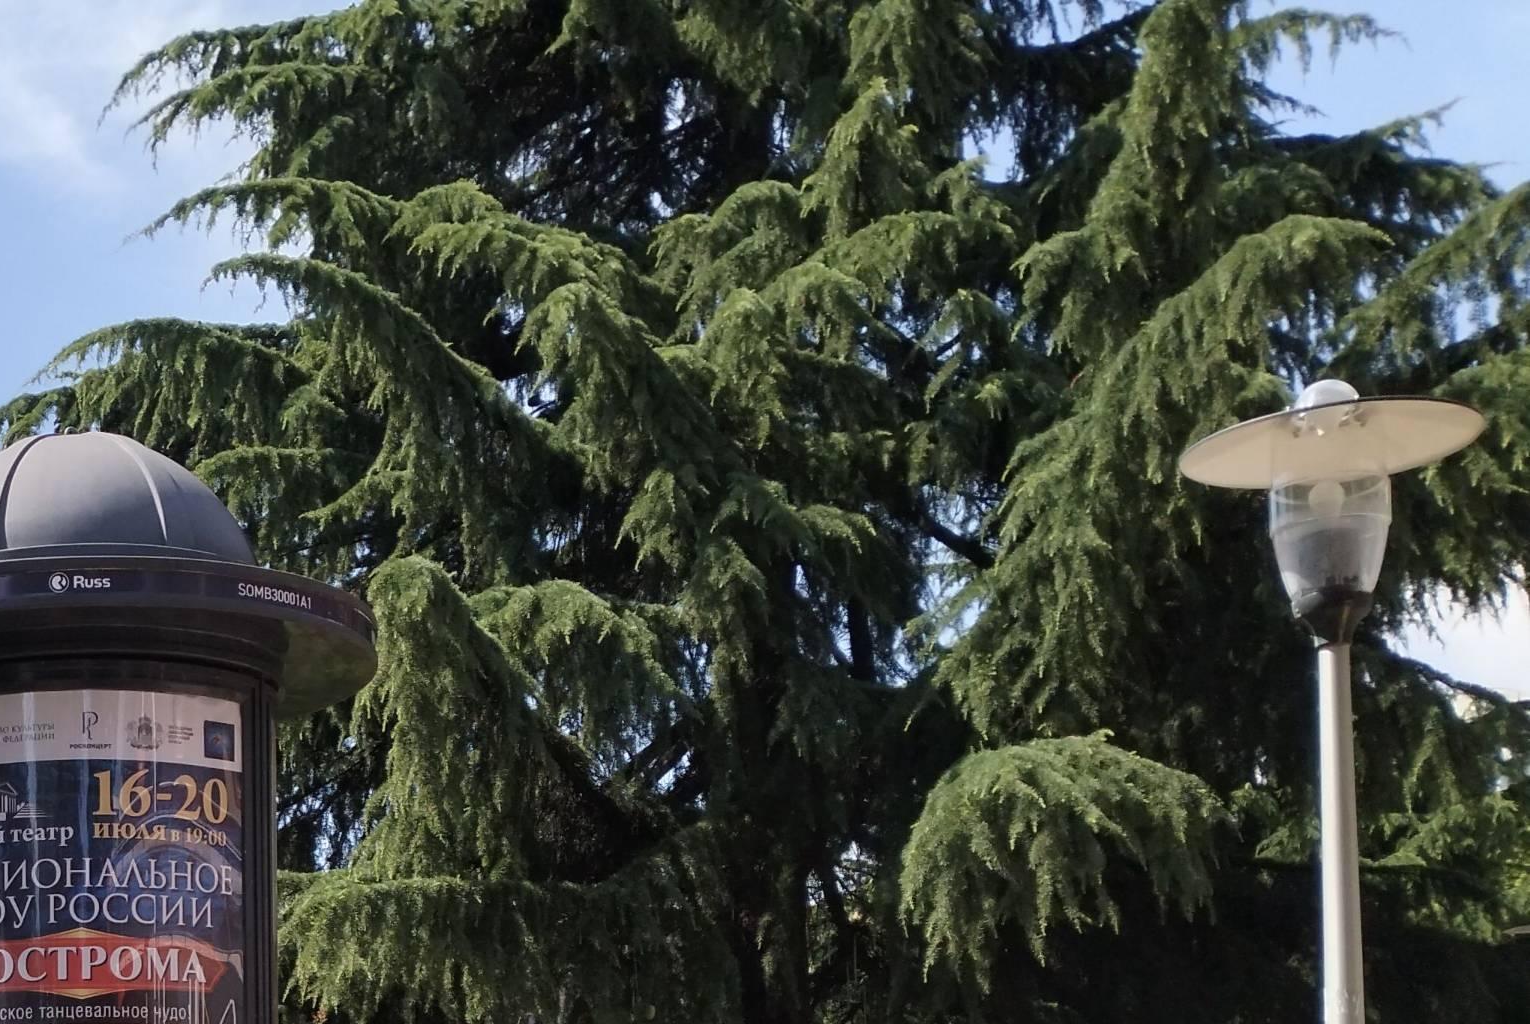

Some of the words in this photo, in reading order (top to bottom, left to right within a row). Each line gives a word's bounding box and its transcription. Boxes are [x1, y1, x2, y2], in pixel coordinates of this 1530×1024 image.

[73, 575, 111, 590] Russ
[238, 582, 312, 609] SOMB30001A1
[92, 769, 229, 824] 16-20
[10, 825, 74, 847] театр
[186, 827, 227, 847] 19:00
[45, 893, 214, 929] РОССИИ
[39, 1005, 148, 1024] танцевальное
